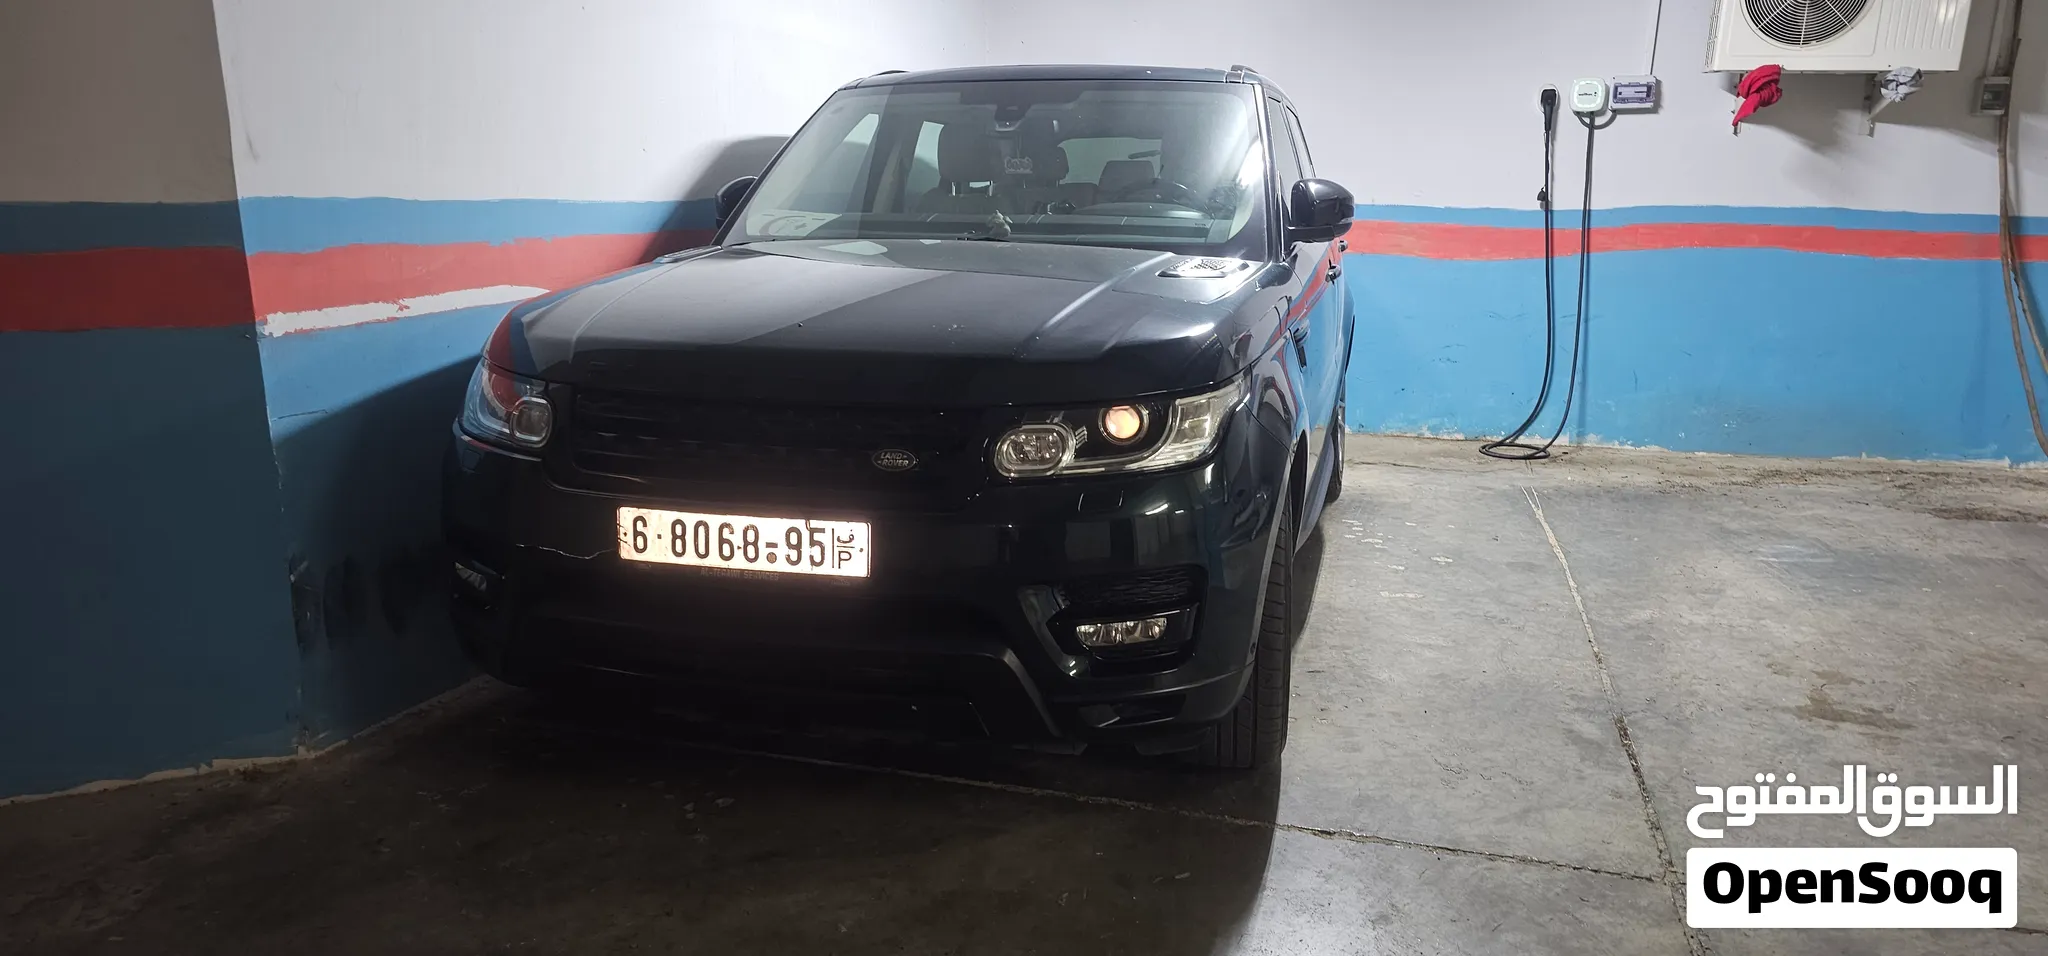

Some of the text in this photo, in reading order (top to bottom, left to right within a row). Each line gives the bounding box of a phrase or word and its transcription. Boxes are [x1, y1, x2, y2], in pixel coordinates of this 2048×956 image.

[880, 452, 903, 460] LAND
[881, 459, 909, 467] ROVER
[838, 550, 852, 569] P
